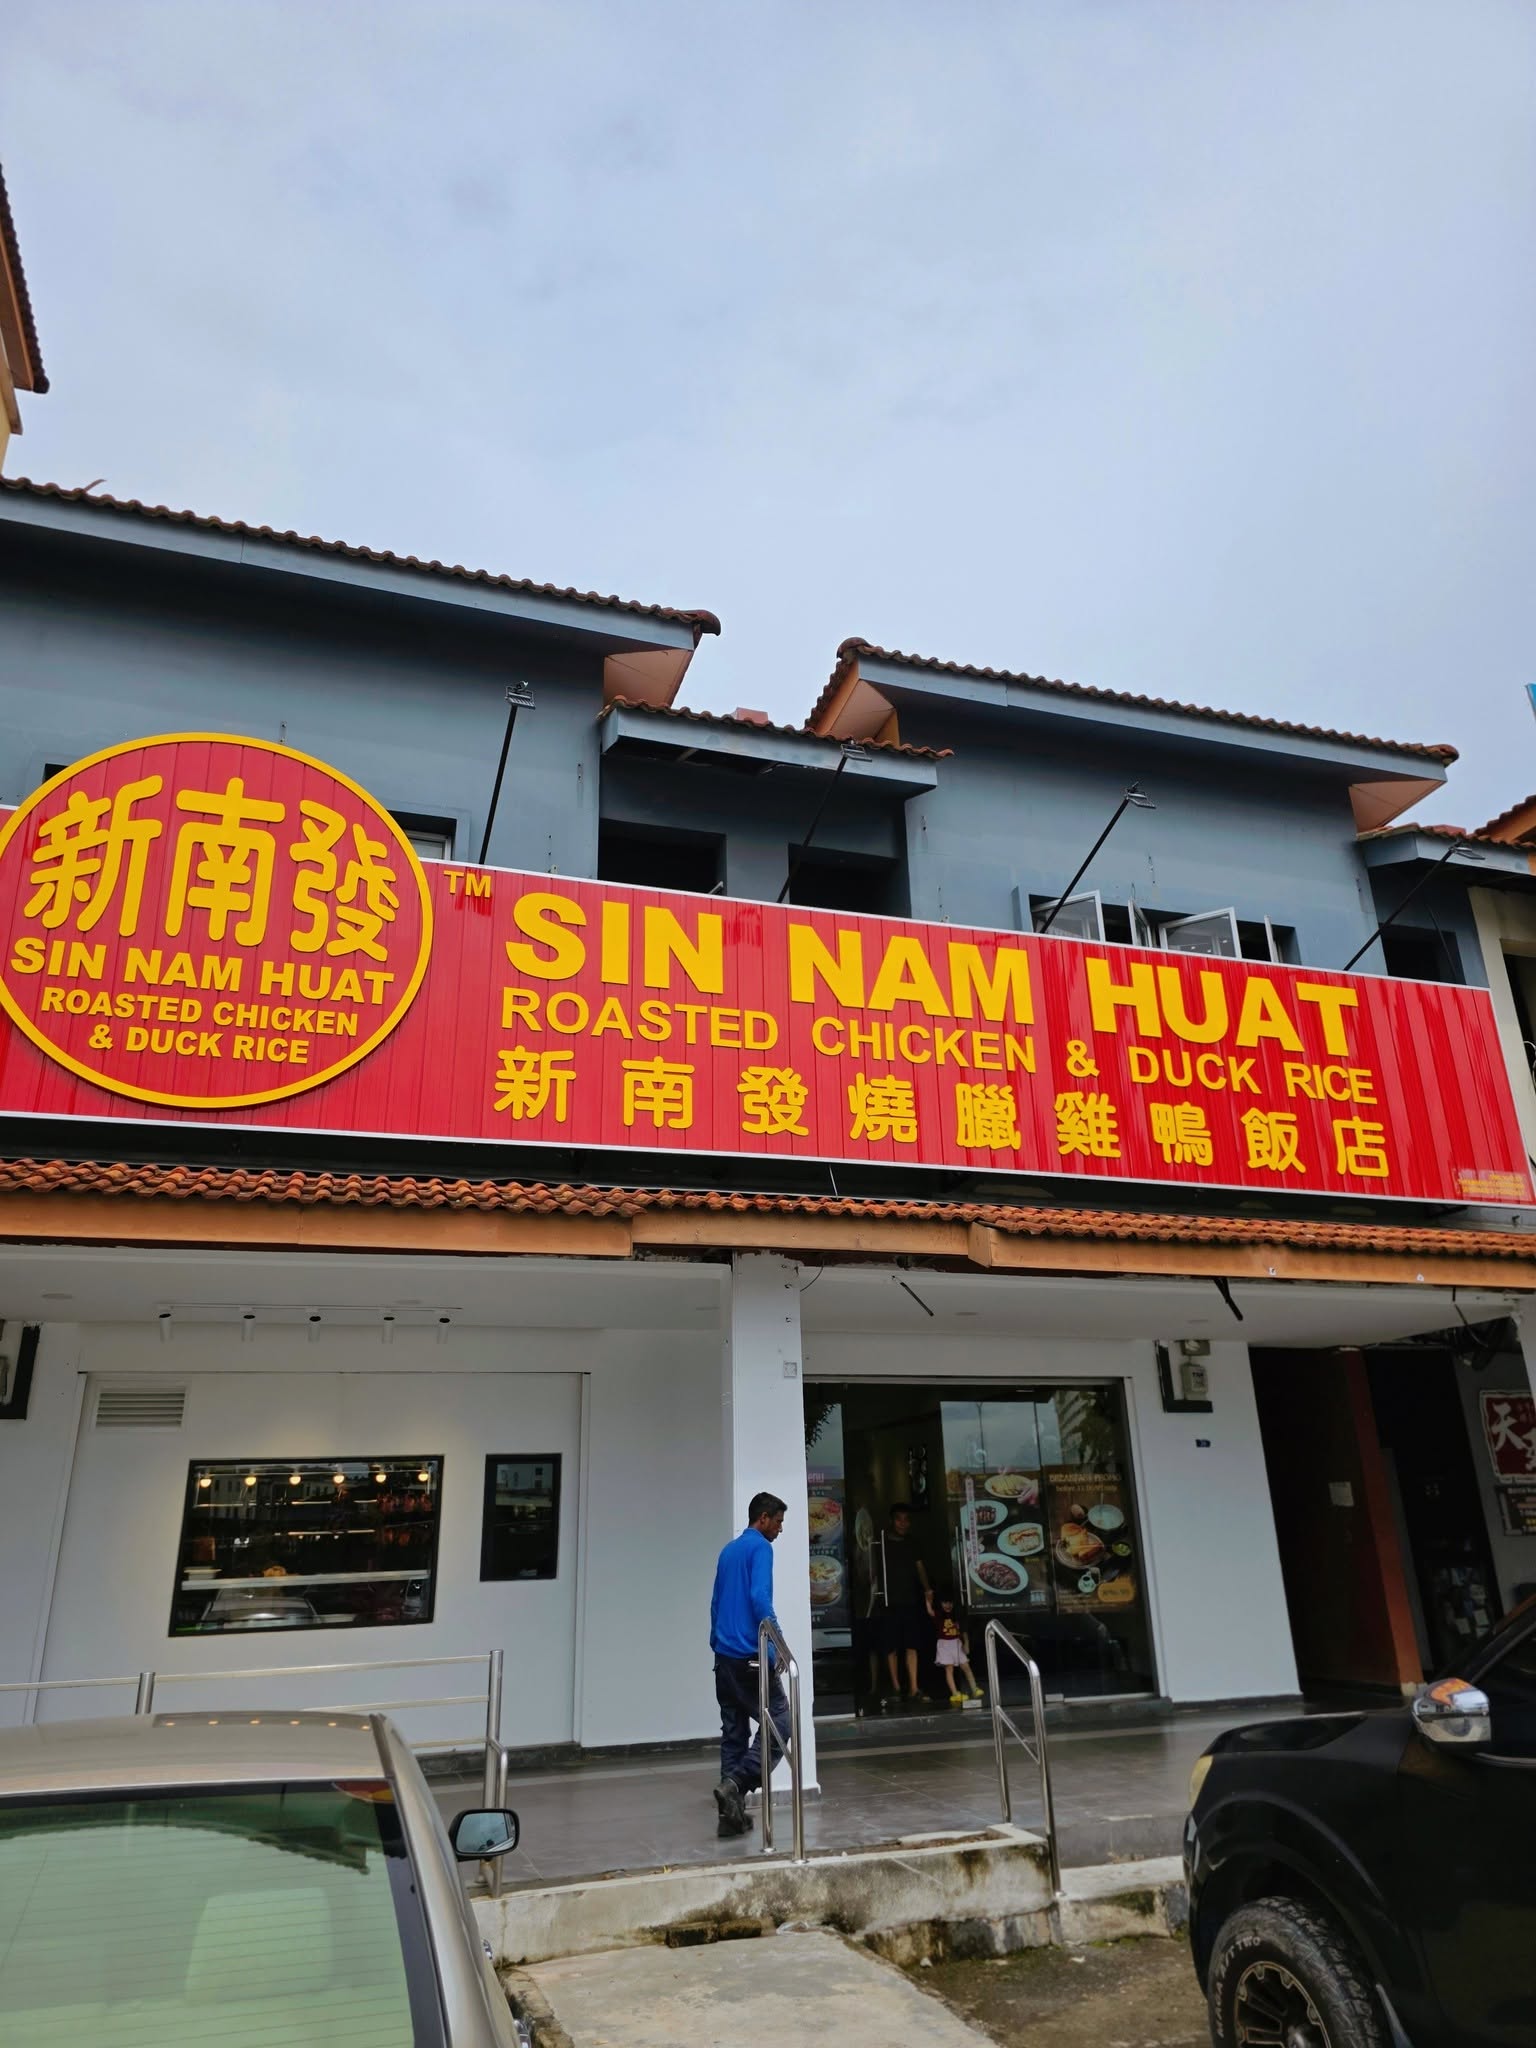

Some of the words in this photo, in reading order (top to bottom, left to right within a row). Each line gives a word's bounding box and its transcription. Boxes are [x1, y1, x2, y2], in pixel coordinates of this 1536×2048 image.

[23, 775, 400, 962] 新南發
[444, 870, 491, 897] TM
[11, 937, 107, 979] SIN
[124, 948, 243, 992] NAM
[260, 961, 394, 1005] HUAT
[506, 892, 724, 994] SIN
[788, 923, 1034, 1025] NAM
[1086, 957, 1358, 1057] HUAT
[41, 987, 202, 1023] ROASTED
[213, 1001, 358, 1036] CHICKEN
[89, 1024, 113, 1049] &
[126, 1026, 222, 1057] DUCK
[233, 1035, 309, 1064] RICE
[501, 986, 778, 1050] ROASTED
[811, 1016, 1036, 1073] CHICKEN
[1066, 1039, 1099, 1078] &
[1128, 1046, 1260, 1094] DUCK
[1283, 1062, 1377, 1104] RICE
[808, 1472, 824, 1483] enu
[1235, 1935, 1261, 1951] TWO
